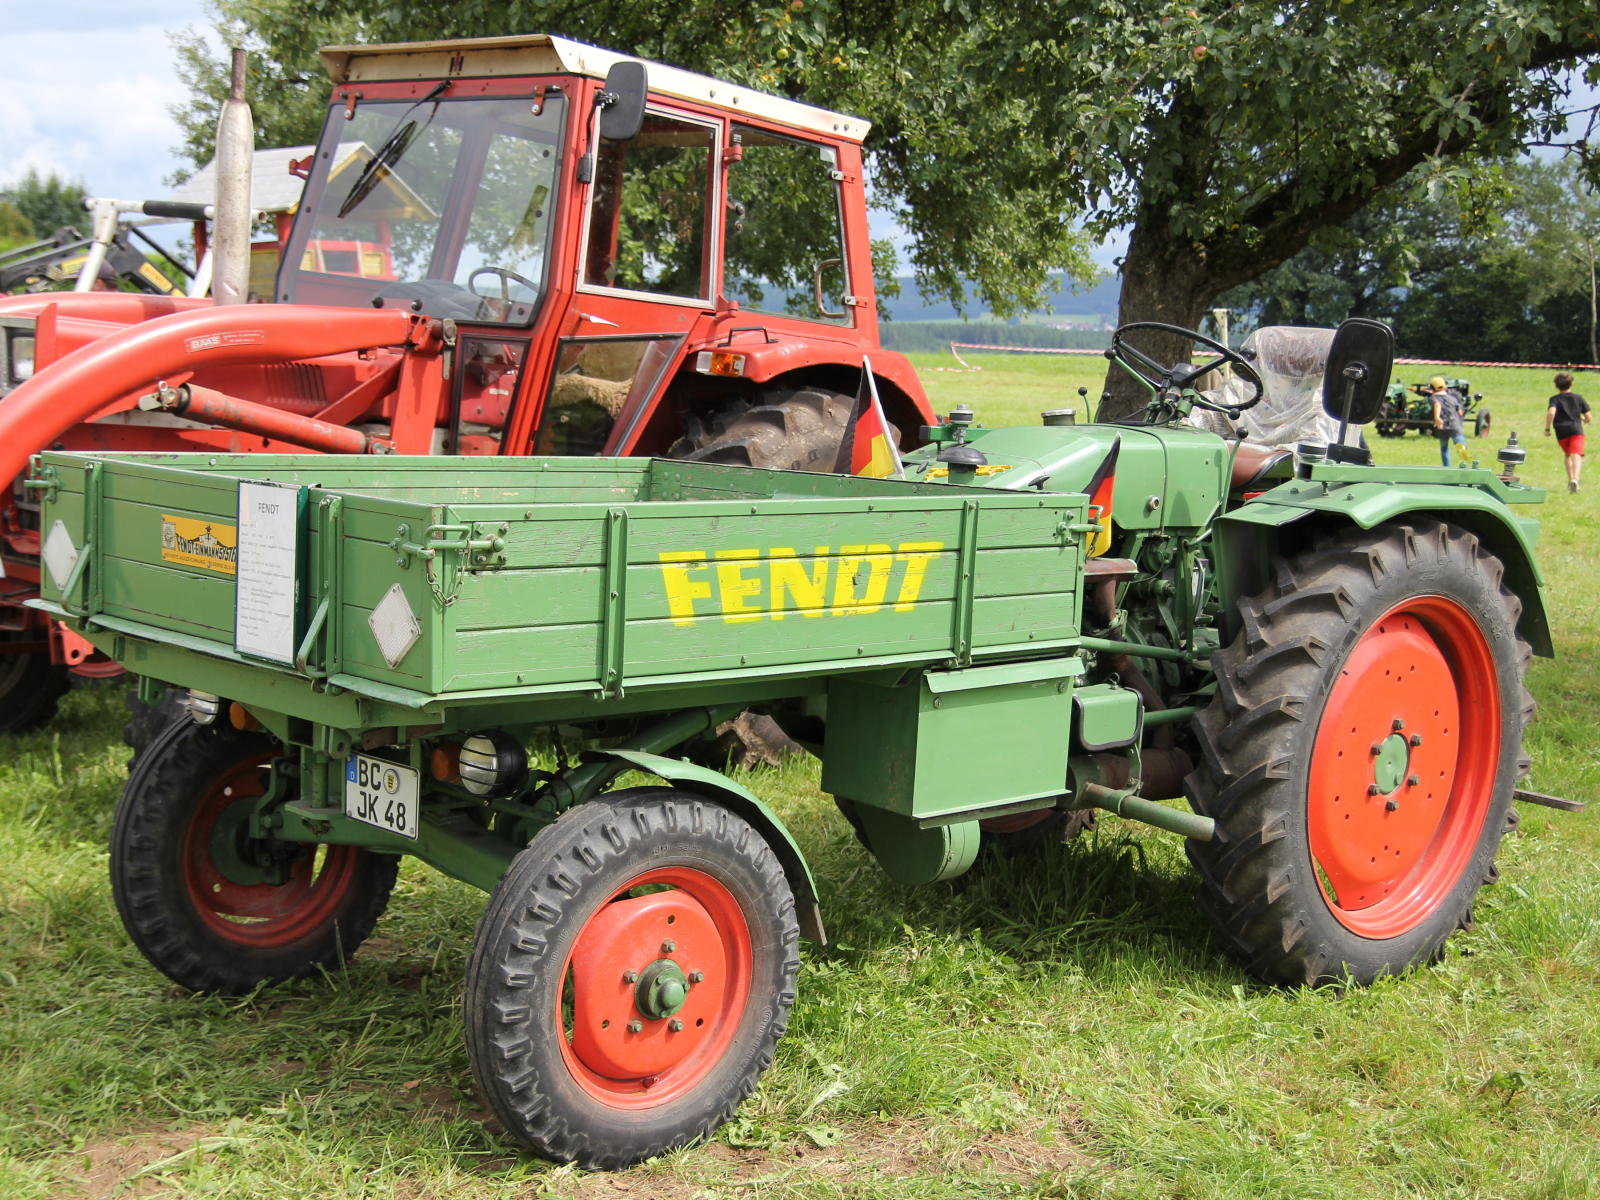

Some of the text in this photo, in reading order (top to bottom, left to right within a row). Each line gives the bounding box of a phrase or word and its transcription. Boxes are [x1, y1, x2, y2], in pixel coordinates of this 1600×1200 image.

[191, 336, 220, 349] BAAS
[257, 502, 280, 515] FENDT
[658, 541, 944, 627] FENDT
[350, 771, 355, 780] D
[358, 758, 381, 791] BC
[357, 790, 407, 832] JK 48
